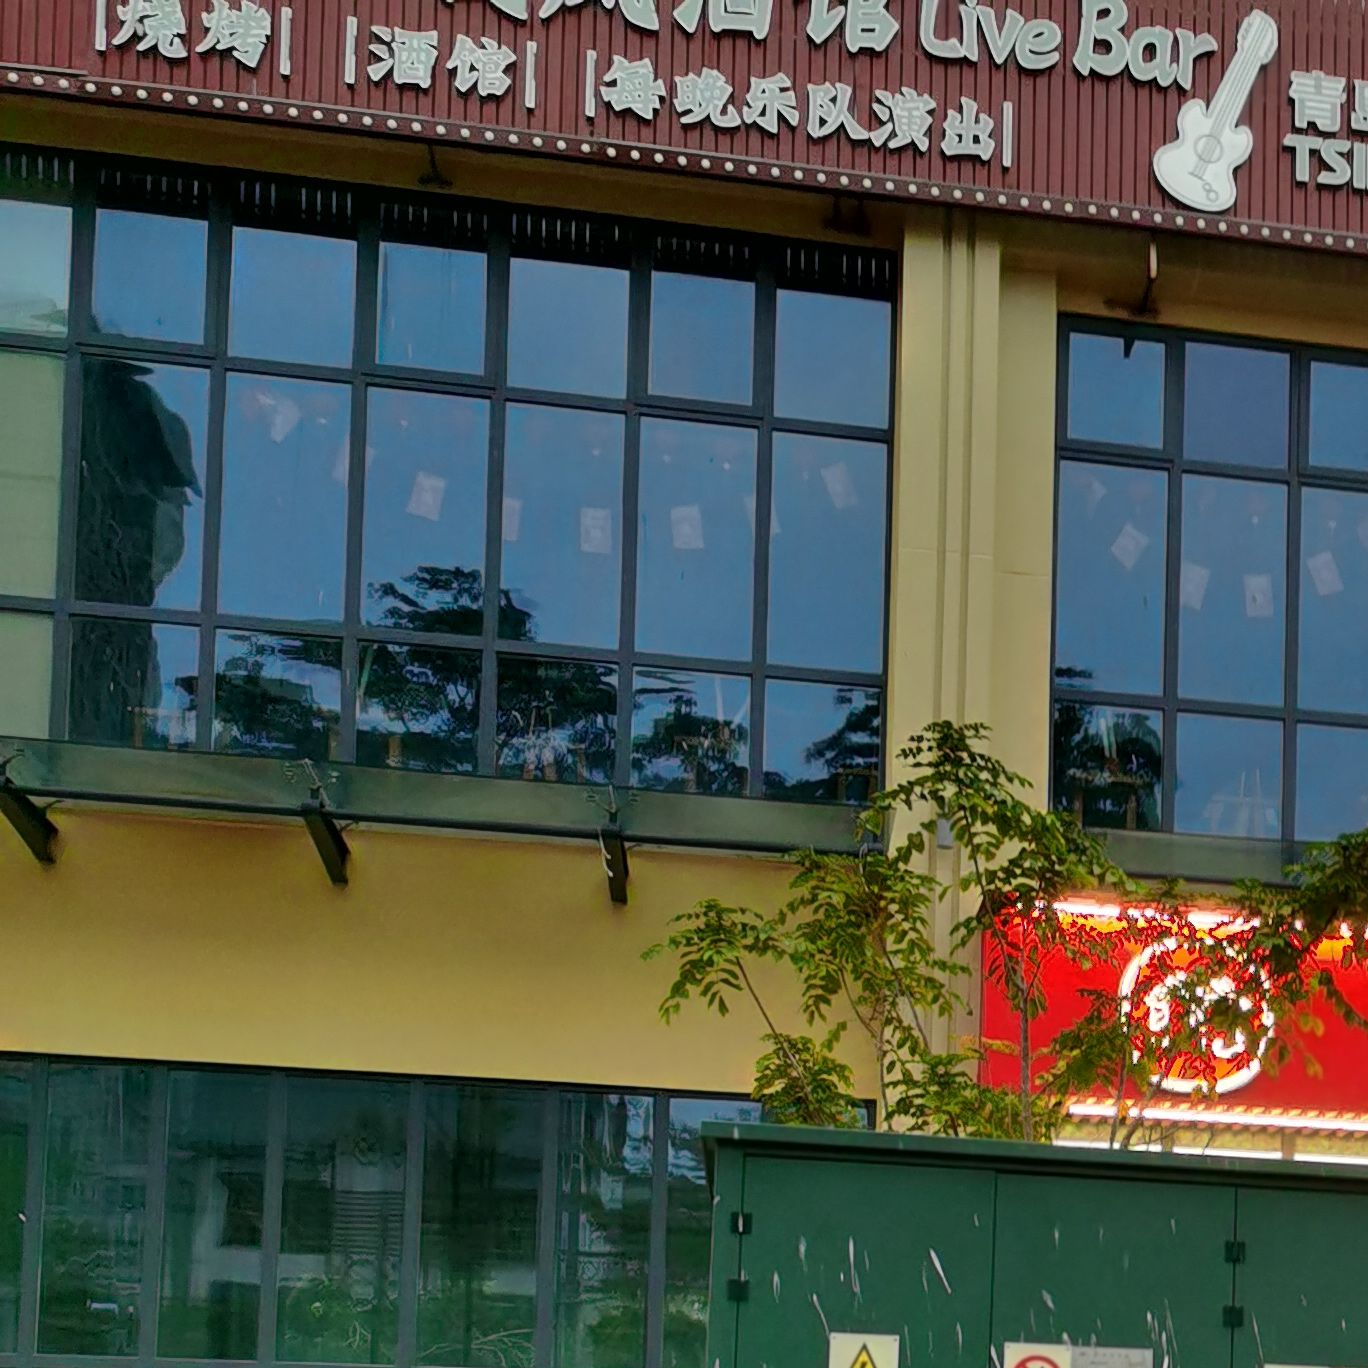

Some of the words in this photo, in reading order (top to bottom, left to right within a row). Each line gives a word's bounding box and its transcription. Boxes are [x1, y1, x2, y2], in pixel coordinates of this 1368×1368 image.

[367, 25, 517, 96] 酒馆
[600, 55, 996, 162] 每晚乐队演出
[920, 0, 1062, 70] Live
[1072, 0, 1219, 91] Bar
